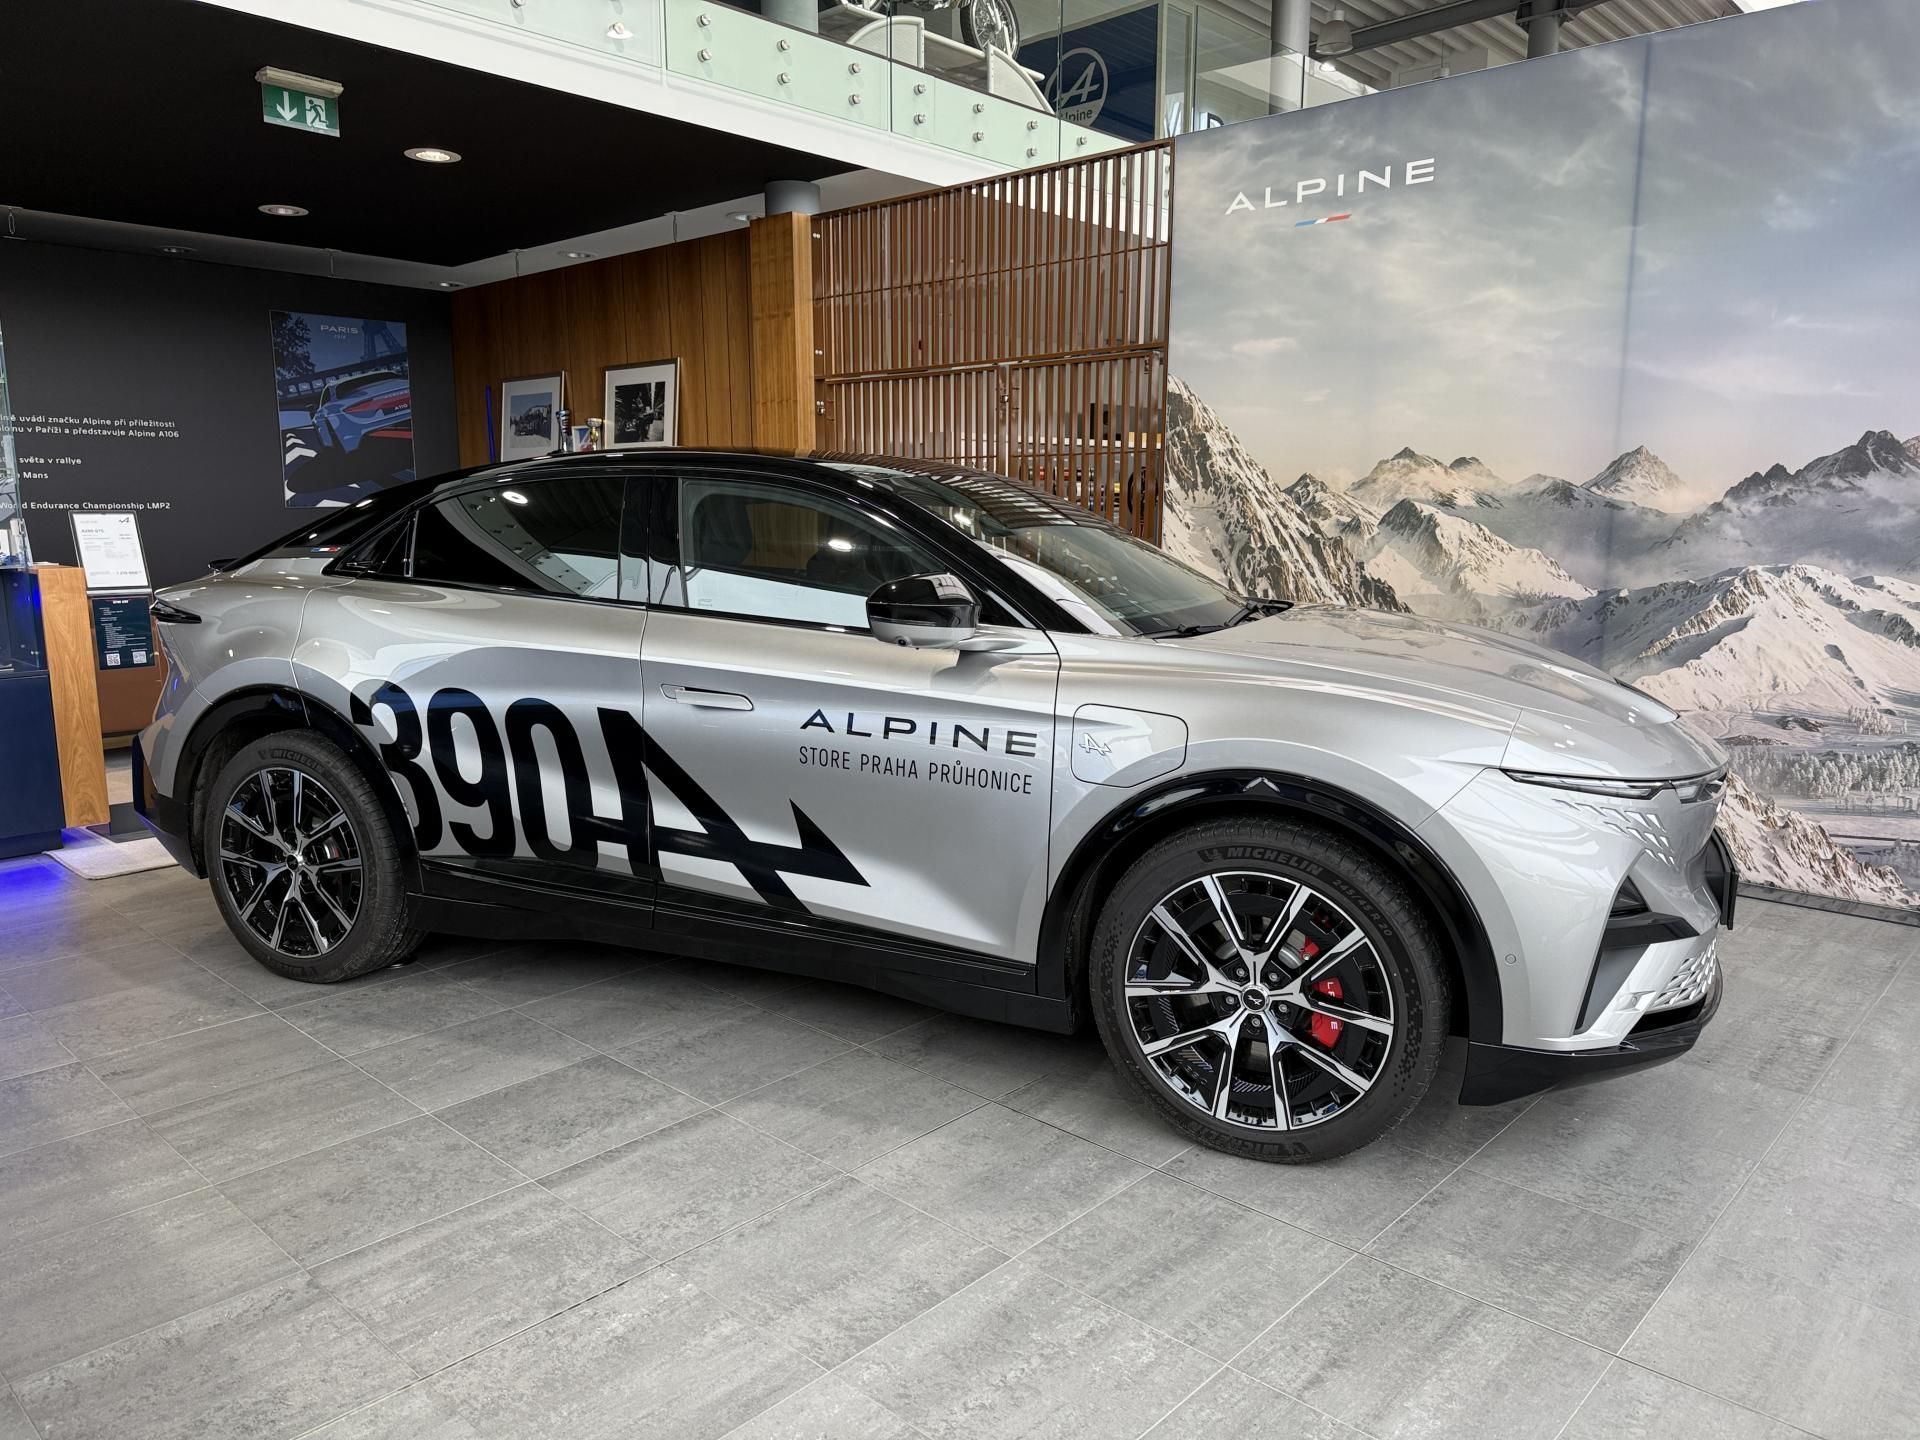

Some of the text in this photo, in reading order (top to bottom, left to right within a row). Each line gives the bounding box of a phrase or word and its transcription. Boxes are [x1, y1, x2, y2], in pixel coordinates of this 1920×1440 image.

[1224, 158, 1435, 215] ALPINE
[320, 325, 359, 334] PARIS
[19, 415, 45, 423] uvádí
[48, 416, 80, 424] značku
[83, 417, 112, 426] Alpine
[114, 419, 127, 427] při
[73, 428, 126, 436] představuje
[128, 429, 156, 438] Alpine
[19, 456, 45, 464] světa
[56, 456, 82, 466] rallye
[30, 502, 80, 510] Endurance
[82, 502, 145, 511] Championship
[800, 708, 1038, 758] ALPINE
[799, 746, 1033, 795] STORE PRAHA PRŮHONICE
[1227, 847, 1324, 876] MICHELIN
